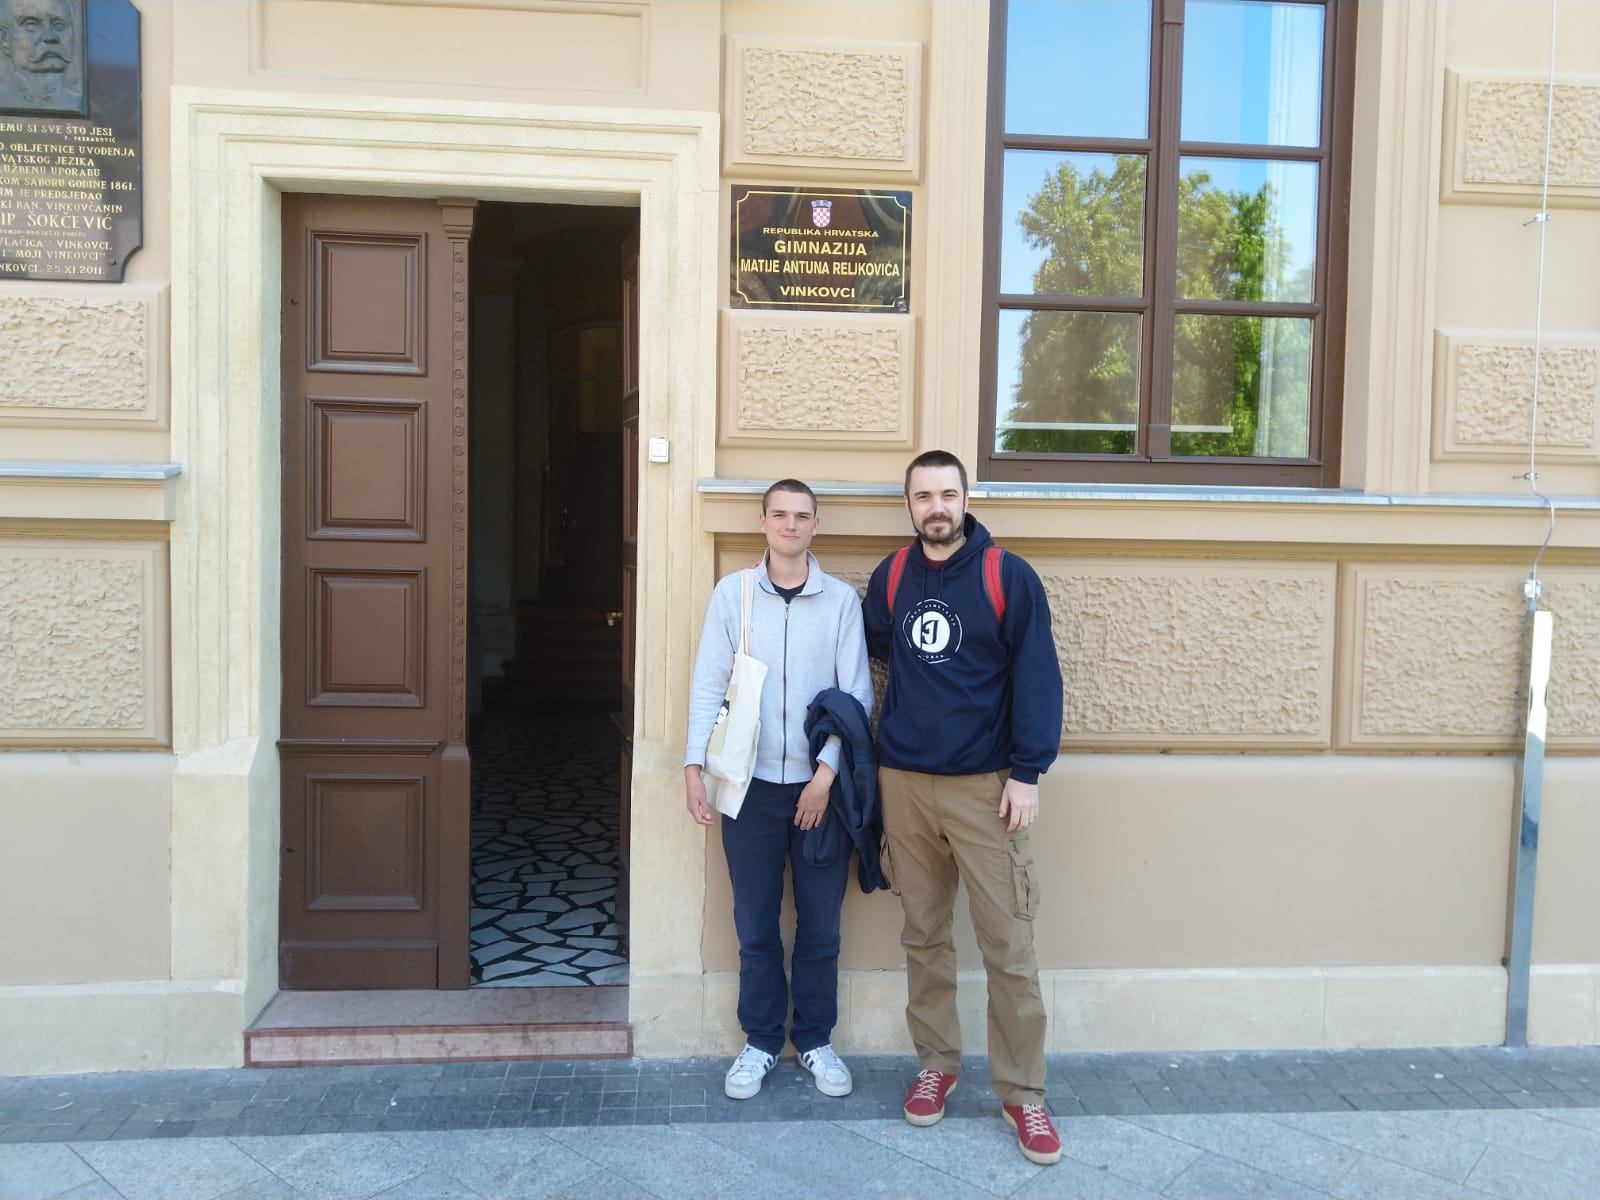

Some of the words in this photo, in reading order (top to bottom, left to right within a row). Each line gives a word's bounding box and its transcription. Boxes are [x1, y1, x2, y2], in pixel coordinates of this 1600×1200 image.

[27, 124, 36, 133] SI
[41, 124, 62, 134] SVE
[66, 122, 86, 135] ŠTO
[89, 127, 112, 136] JESI
[10, 143, 74, 154] OBLJETNICE
[54, 156, 95, 166] JEZIKA
[51, 166, 100, 177] UPORABU
[24, 178, 65, 187] SABORU
[68, 180, 106, 190] GODINE
[110, 182, 136, 191] 1861.
[34, 189, 102, 200] PREDSJEDAO
[46, 202, 123, 214] VINKOVČANIN
[28, 210, 112, 230] ŠOKČEVIĆ
[762, 227, 821, 236] REPUBLIKA
[824, 228, 879, 238] HRVATSKA
[774, 240, 868, 256] GIMNAZIJA
[740, 258, 780, 273] MATIJE
[782, 260, 830, 275] ANTUNA
[832, 260, 900, 276] RELJKOVIĆA
[780, 285, 855, 298] VINKOVCI
